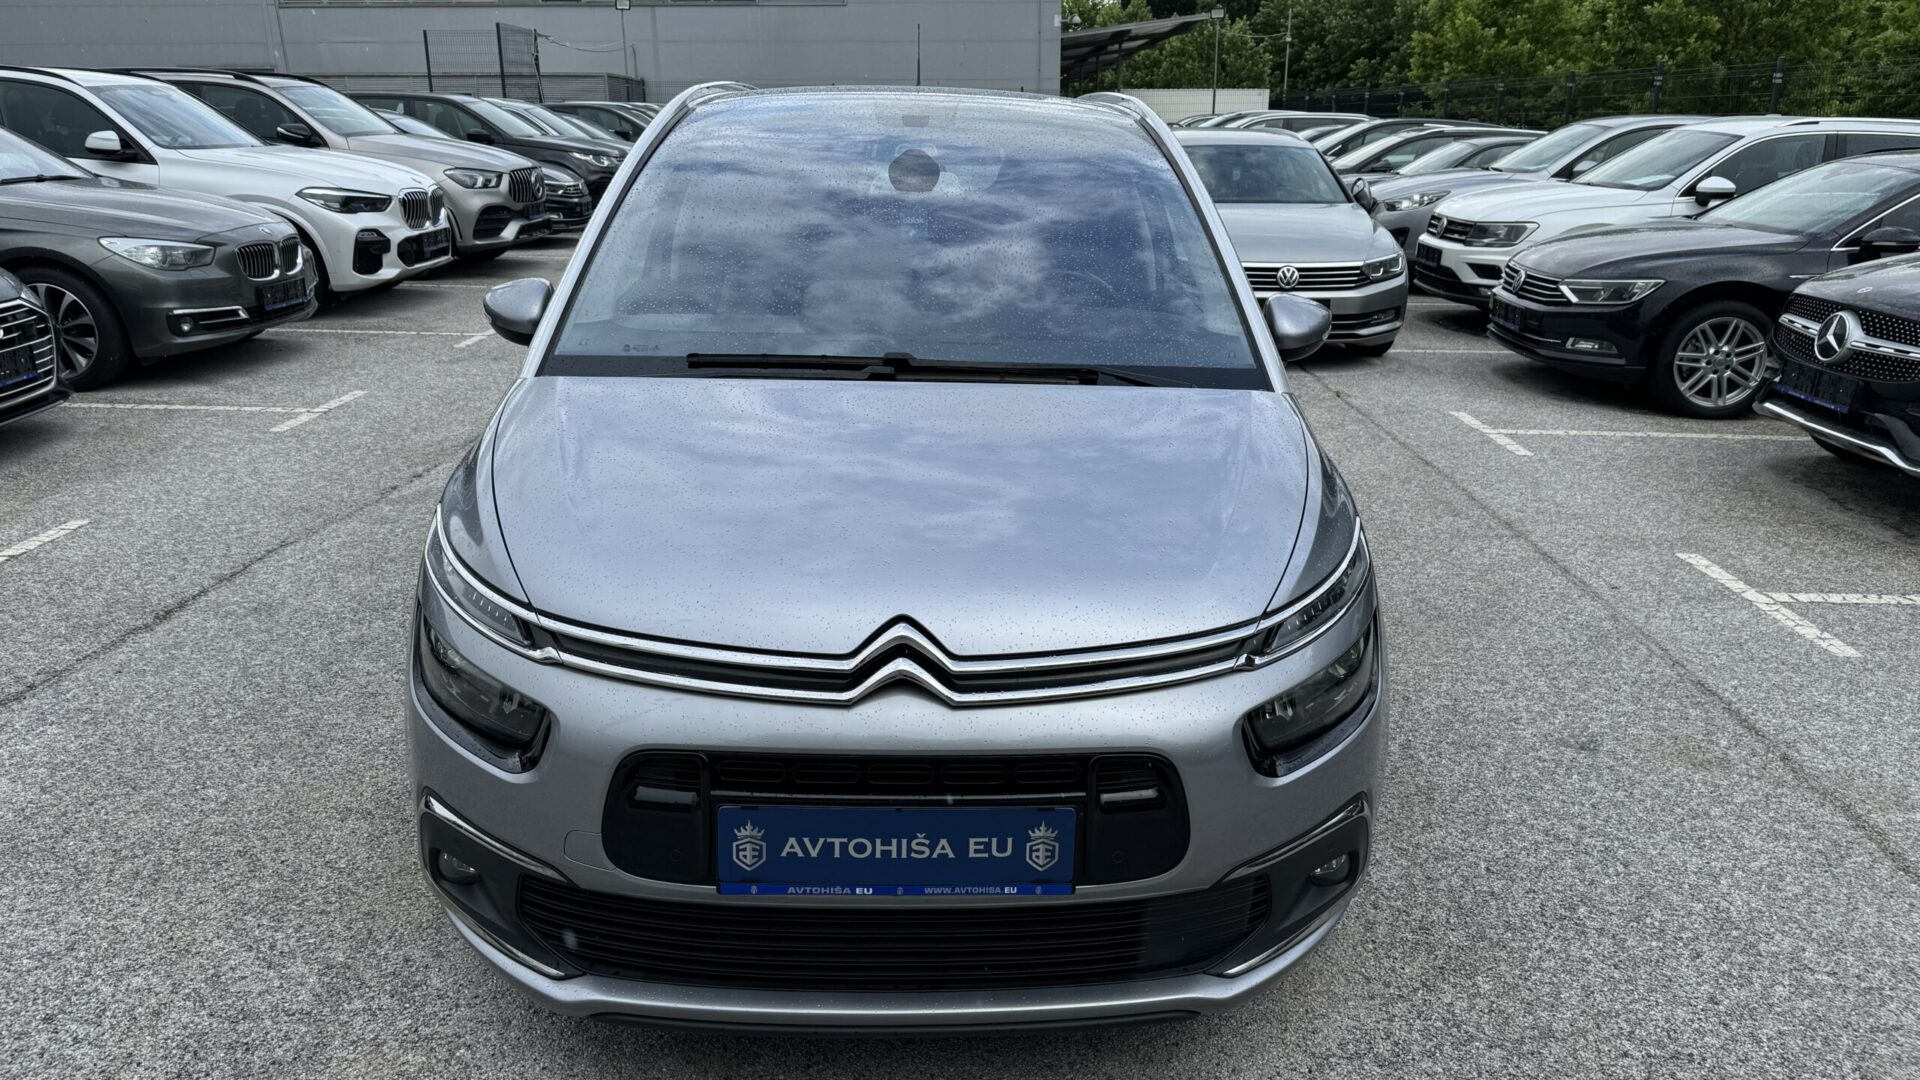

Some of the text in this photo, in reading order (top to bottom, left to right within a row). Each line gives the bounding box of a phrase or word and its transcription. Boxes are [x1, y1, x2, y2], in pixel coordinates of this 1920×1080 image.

[780, 833, 1014, 858] AVTOHIŠA EU
[787, 886, 873, 895] AVTOHIŠA EU
